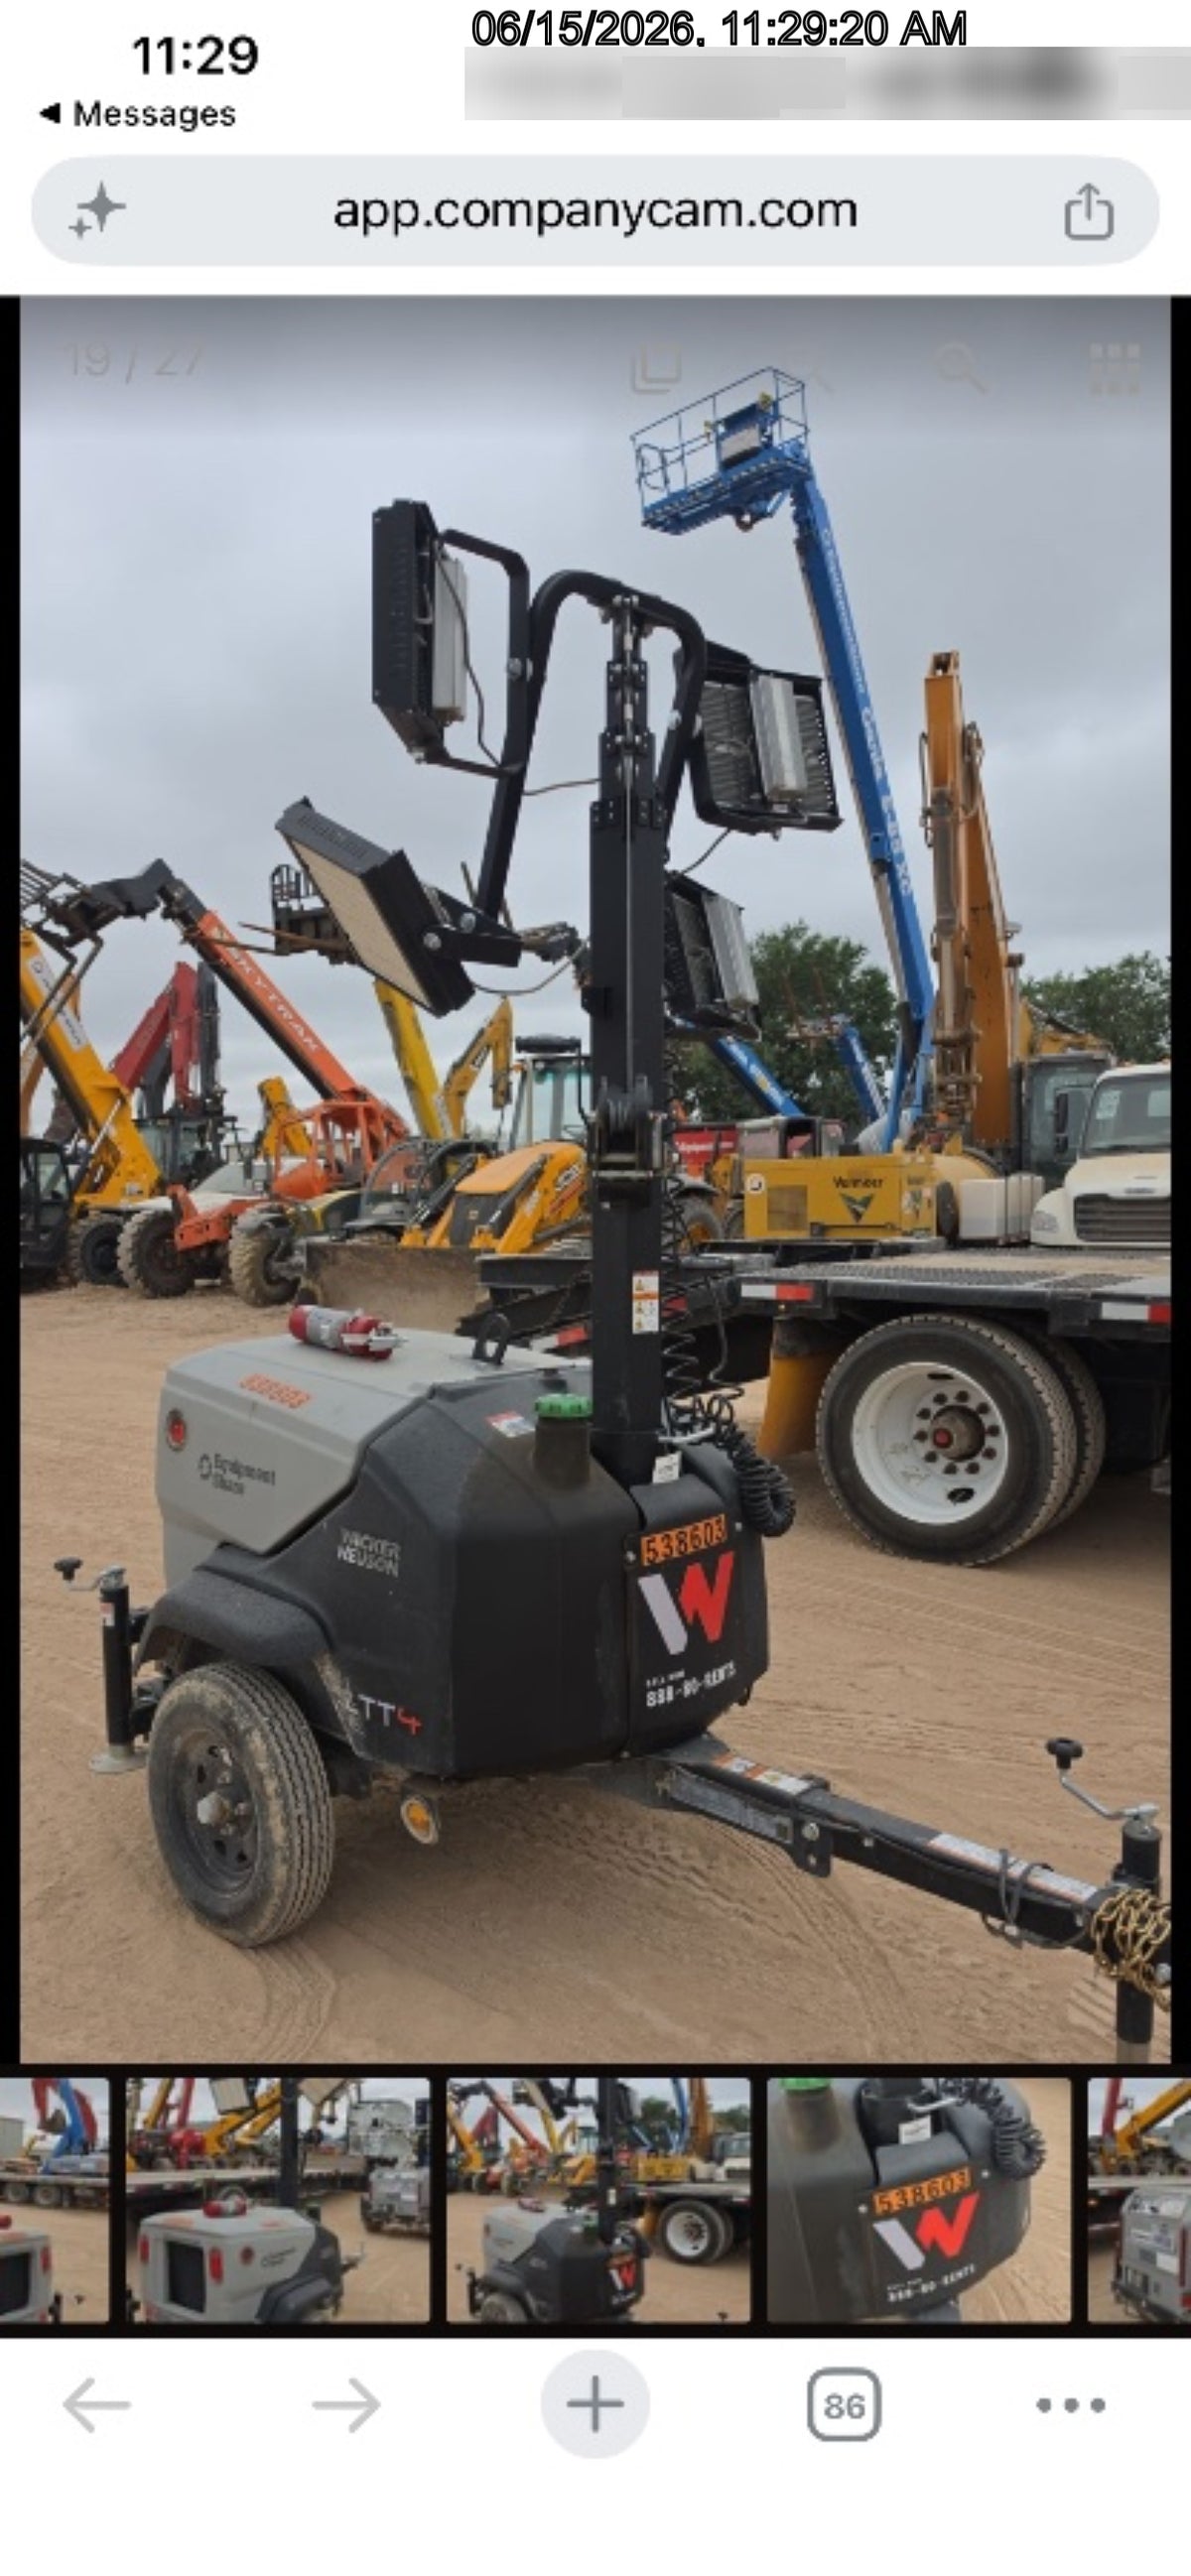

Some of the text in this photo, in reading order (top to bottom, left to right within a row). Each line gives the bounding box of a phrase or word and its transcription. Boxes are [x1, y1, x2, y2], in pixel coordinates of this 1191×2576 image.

[134, 36, 258, 74] 11:29
[74, 101, 235, 132] Messages
[334, 199, 857, 237] app.companycam.com
[645, 1515, 727, 1564] 538603
[825, 2393, 864, 2419] 86
